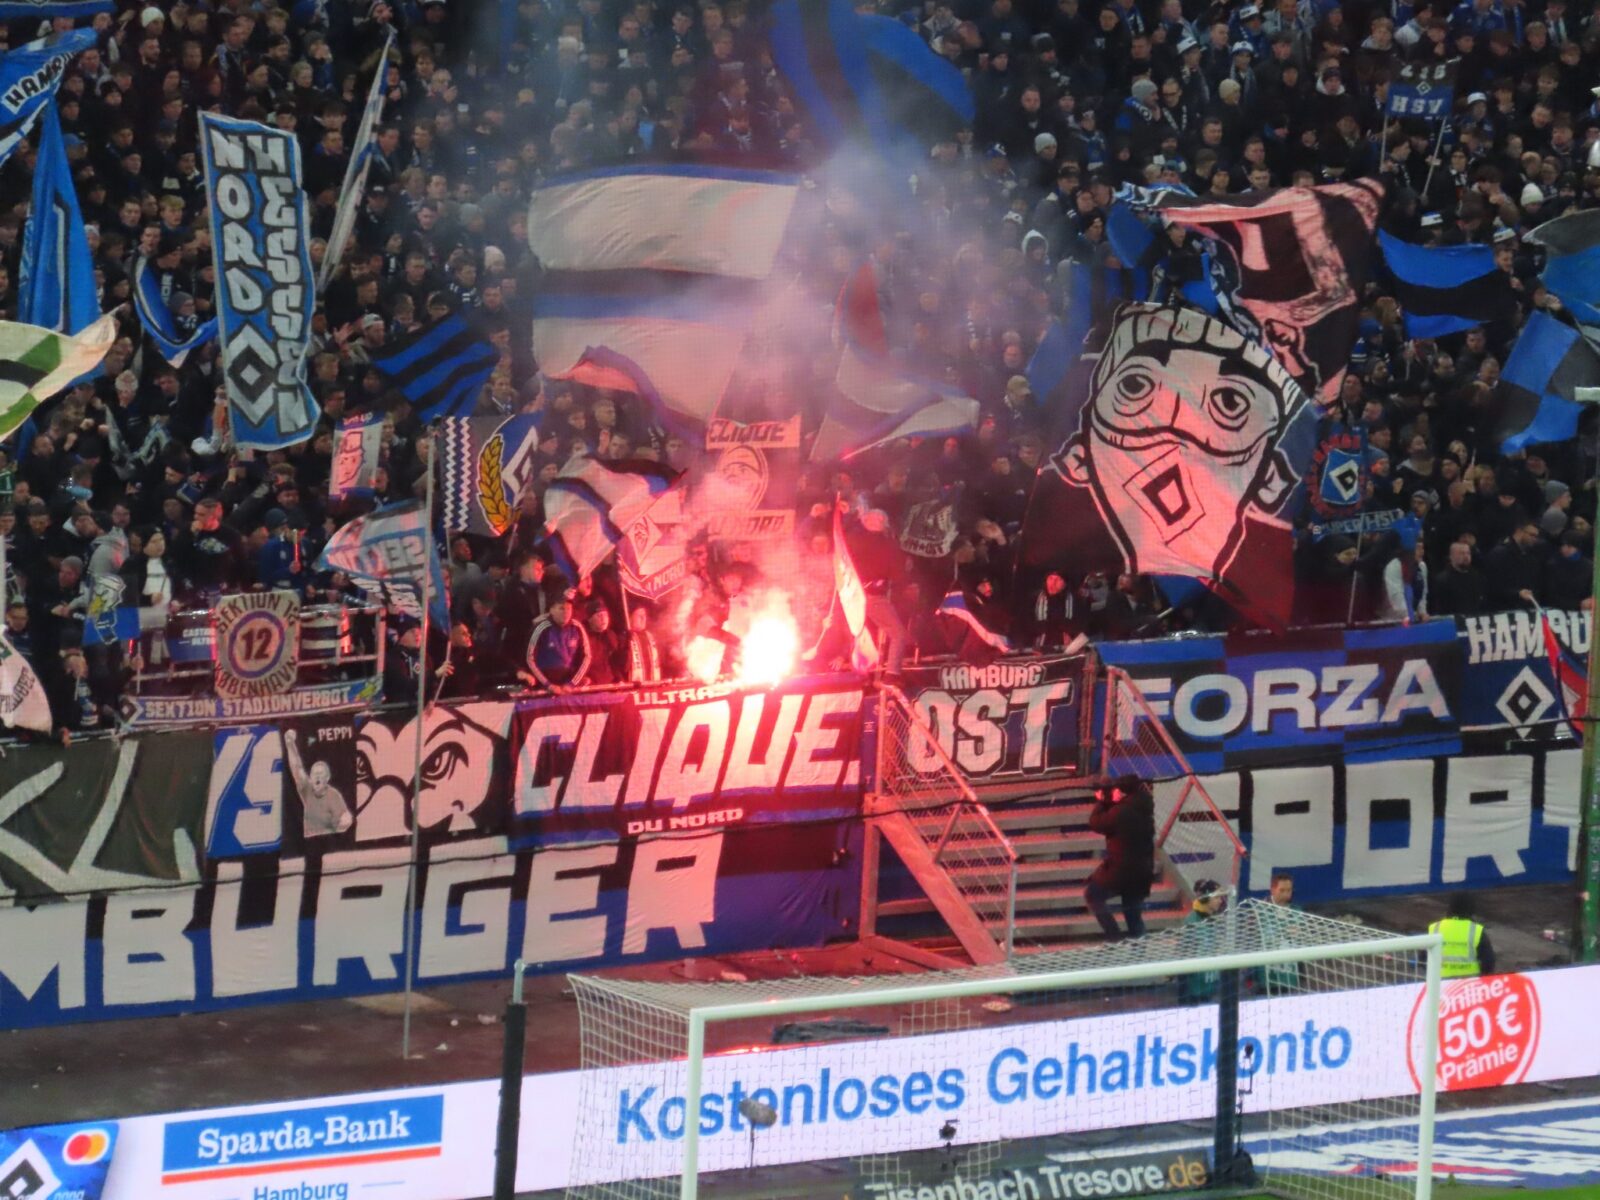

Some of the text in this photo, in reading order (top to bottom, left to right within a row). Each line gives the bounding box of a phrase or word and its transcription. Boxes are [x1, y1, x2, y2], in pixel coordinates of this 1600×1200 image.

[1391, 95, 1444, 114] HSV
[210, 128, 263, 311] NORD
[708, 420, 785, 443] CLIQUE
[241, 627, 272, 661] 12
[941, 664, 1042, 690] HAMBURG
[222, 686, 350, 716] STADIONVERBOT
[1115, 658, 1450, 741] FORZA
[318, 726, 353, 742] PEPPI
[907, 681, 1072, 773] OST
[628, 808, 744, 834] DU NORD
[1496, 993, 1523, 1036] €
[986, 1020, 1353, 1104] Gehaltskonto
[1441, 1042, 1519, 1086] Prämie
[197, 1109, 411, 1164] Sparda-Bank
[253, 1181, 348, 1200] Hamburg
